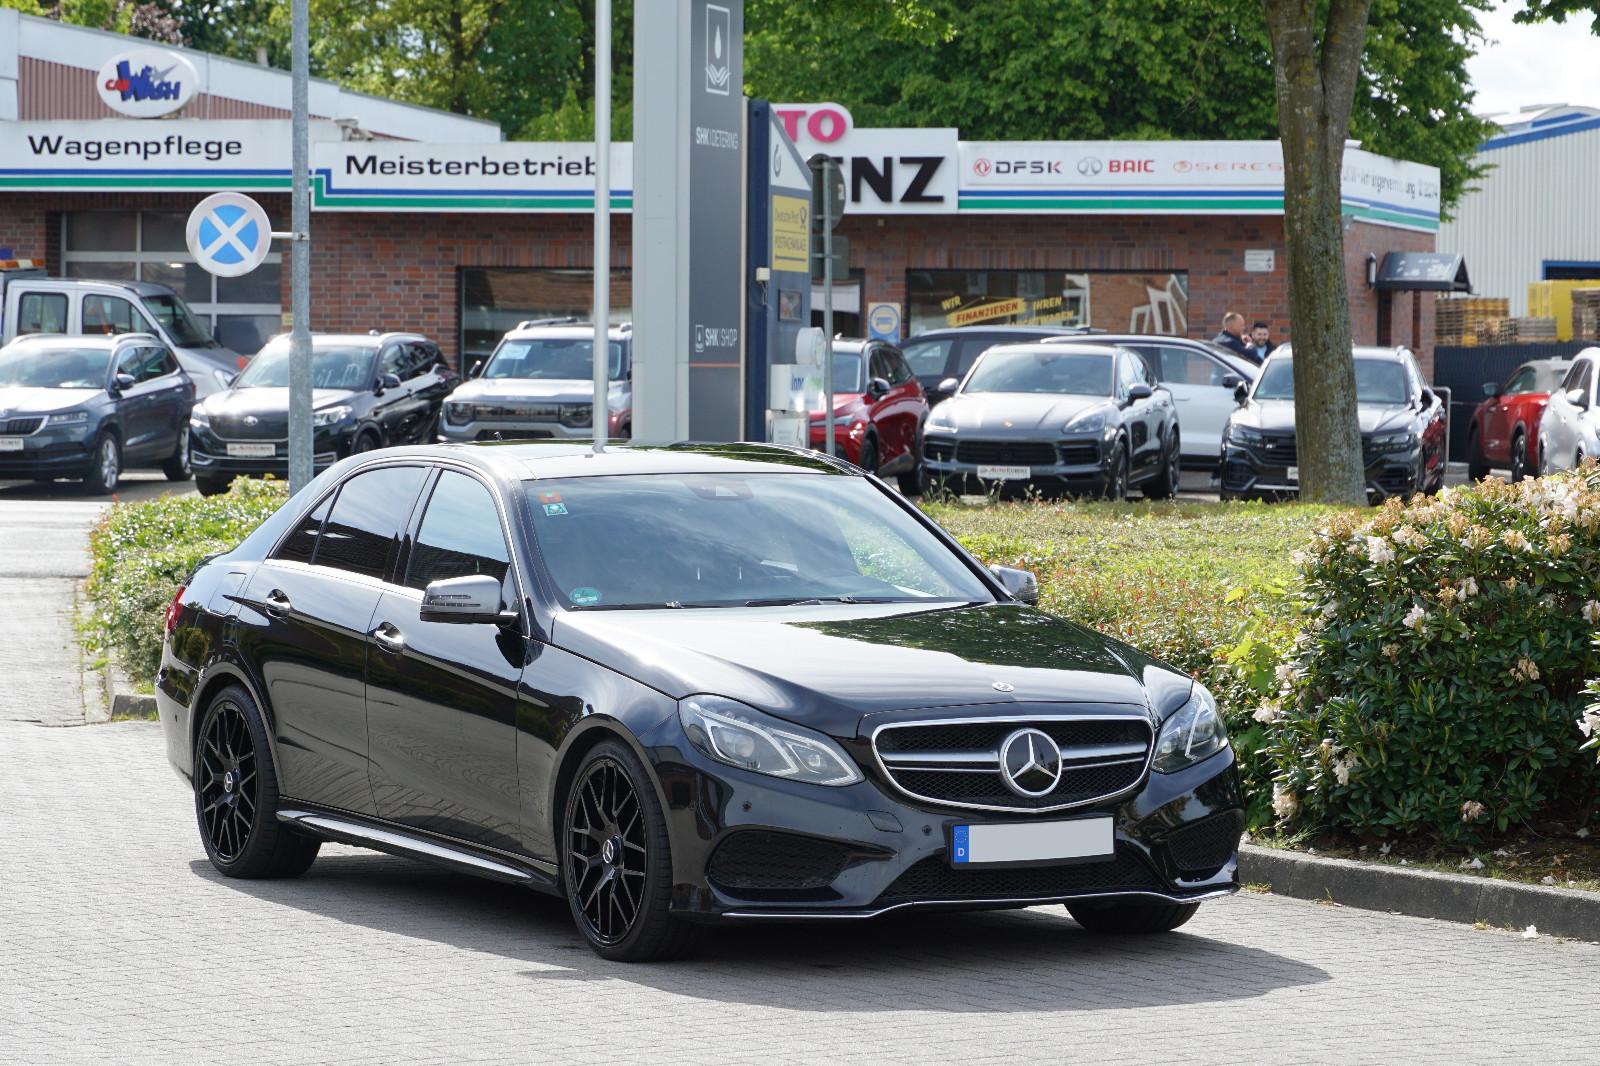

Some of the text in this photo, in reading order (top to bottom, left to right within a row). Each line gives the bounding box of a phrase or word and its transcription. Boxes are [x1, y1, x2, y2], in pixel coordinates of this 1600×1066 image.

[696, 126, 709, 145] SHK
[28, 135, 242, 160] Wagenpflege
[346, 155, 595, 176] Meisterbetrieb
[995, 160, 1062, 174] DFSK
[1108, 159, 1155, 174] BAIC
[1195, 161, 1282, 172] SERES
[829, 156, 945, 203] NZ
[941, 296, 961, 311] WIR
[956, 301, 1019, 322] FINANZIEREN
[1032, 296, 1062, 310] IHREN
[705, 327, 738, 347] SHK SHOP
[957, 847, 965, 857] D
